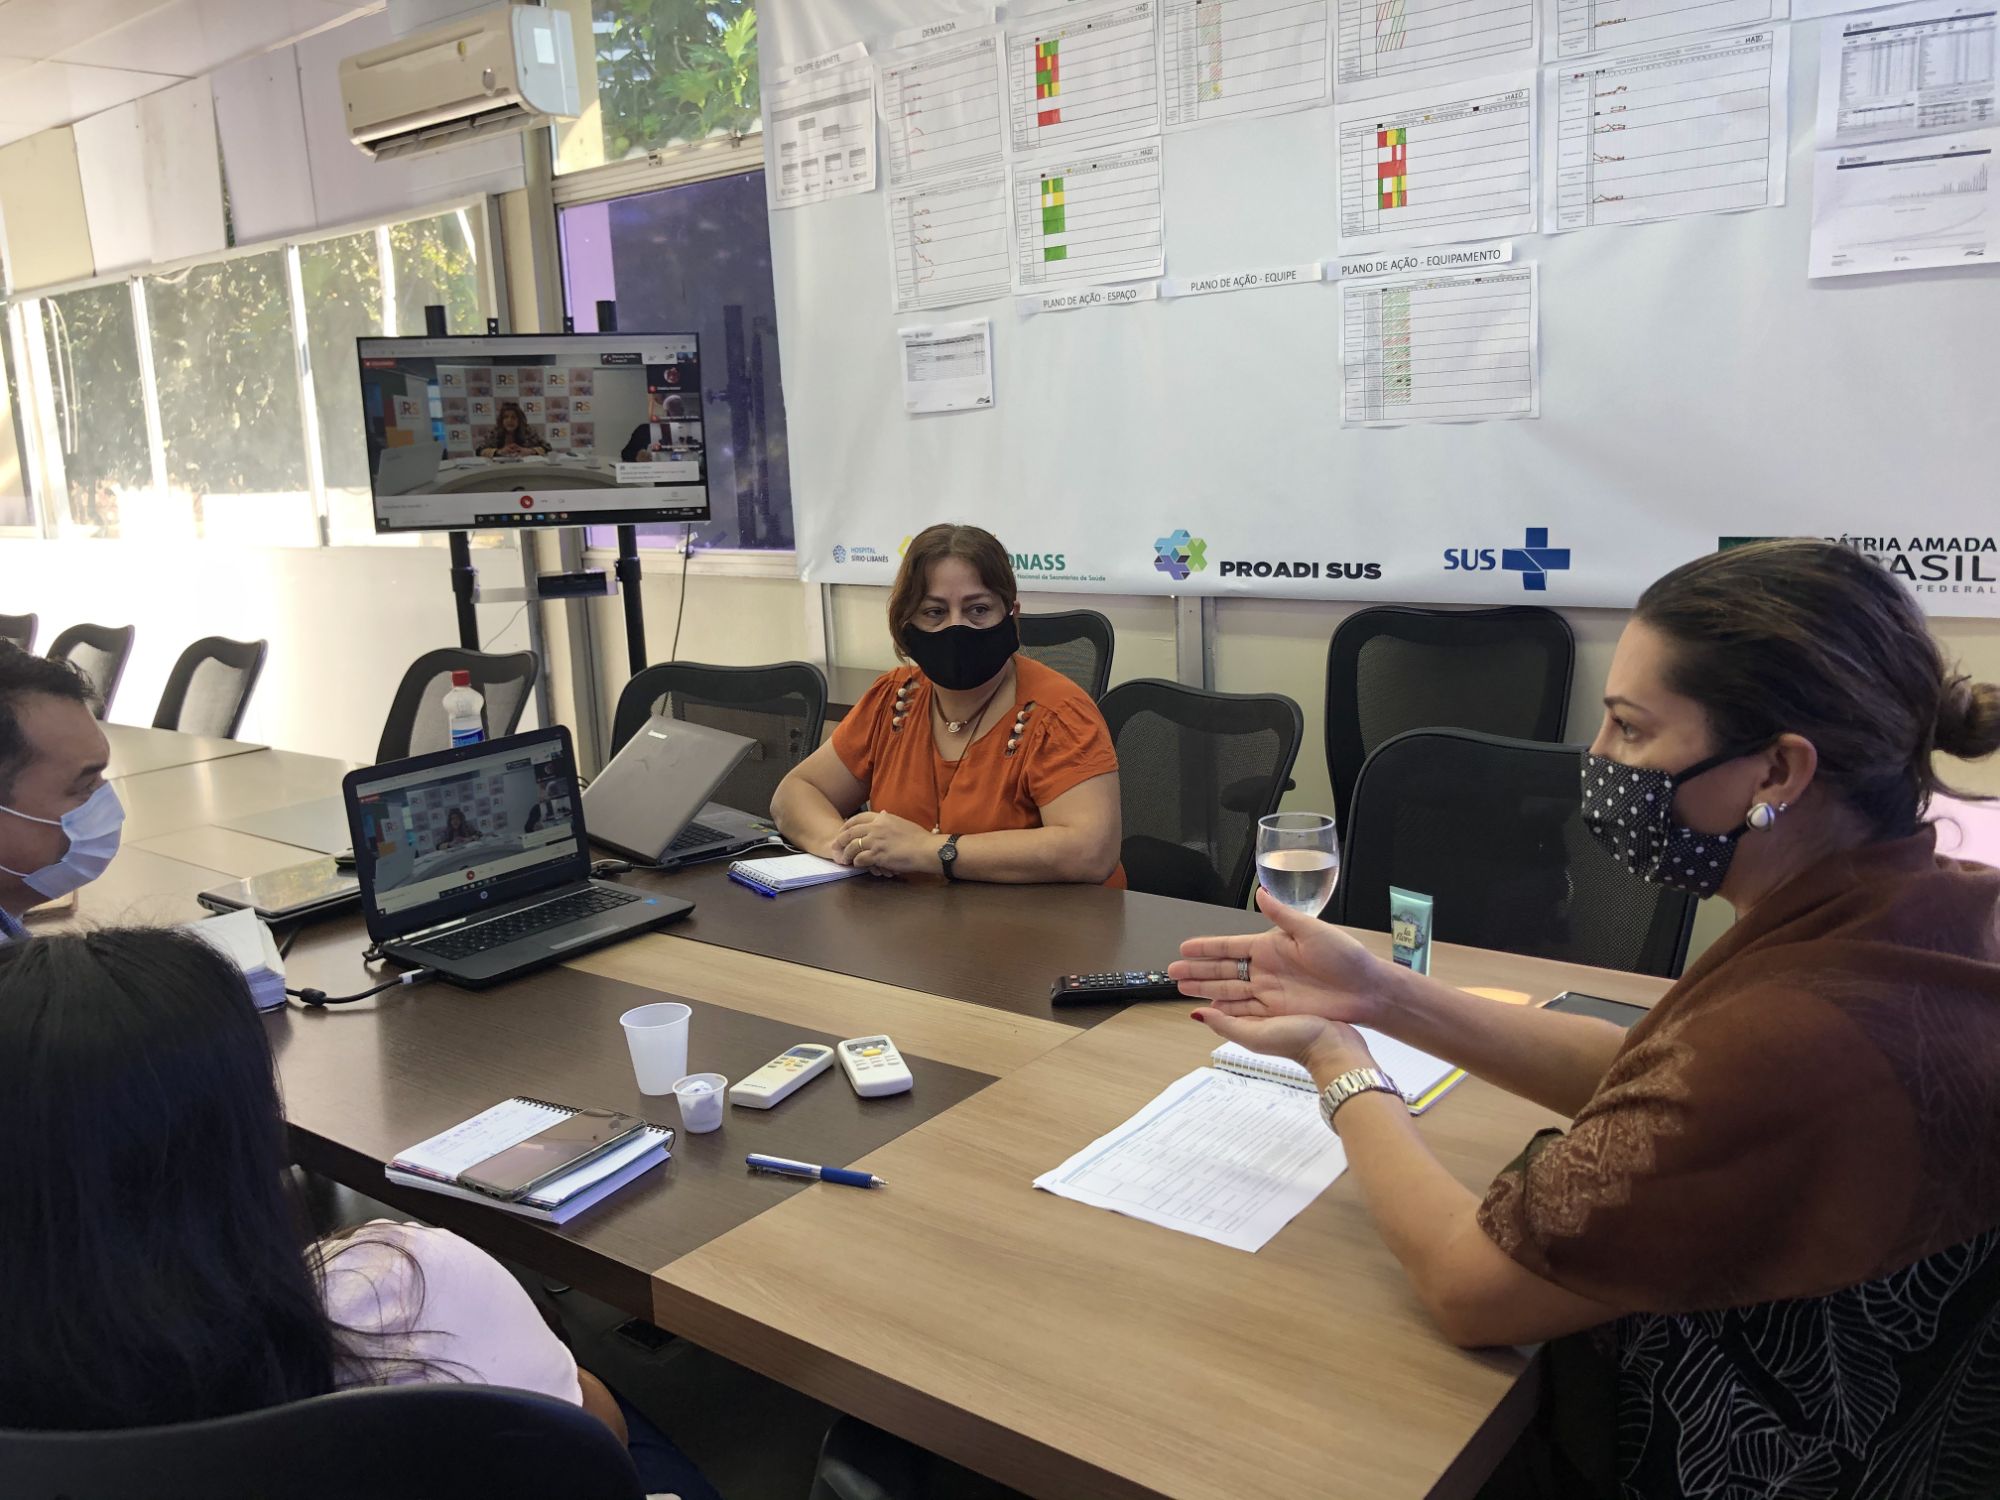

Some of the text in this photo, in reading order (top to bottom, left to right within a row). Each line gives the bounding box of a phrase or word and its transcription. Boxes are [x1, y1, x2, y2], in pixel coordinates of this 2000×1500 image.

[922, 22, 956, 38] DEMANDA
[1505, 91, 1524, 101] MAIO
[1342, 263, 1374, 276] PLANO
[1376, 260, 1388, 272] DE
[1390, 256, 1418, 271] AÇÃO
[1427, 249, 1501, 267] EQUIPAMENTO
[1190, 280, 1218, 292] PLANO
[1220, 278, 1231, 288] DE
[1233, 274, 1258, 287] AÇÃO
[1265, 270, 1297, 283] EQUIPE
[1043, 297, 1066, 308] PLANO
[1068, 296, 1078, 305] DE
[1079, 292, 1101, 305] AÇÃO
[1107, 289, 1137, 301] ESPAÇO
[851, 546, 876, 554] HOSPITAL
[1908, 537, 1998, 553] AMADA
[1443, 548, 1496, 571] SUS
[1866, 554, 1997, 582] ASIL
[1219, 561, 1382, 580] PROADI SUS
[1916, 584, 1997, 594] FEDERAL
